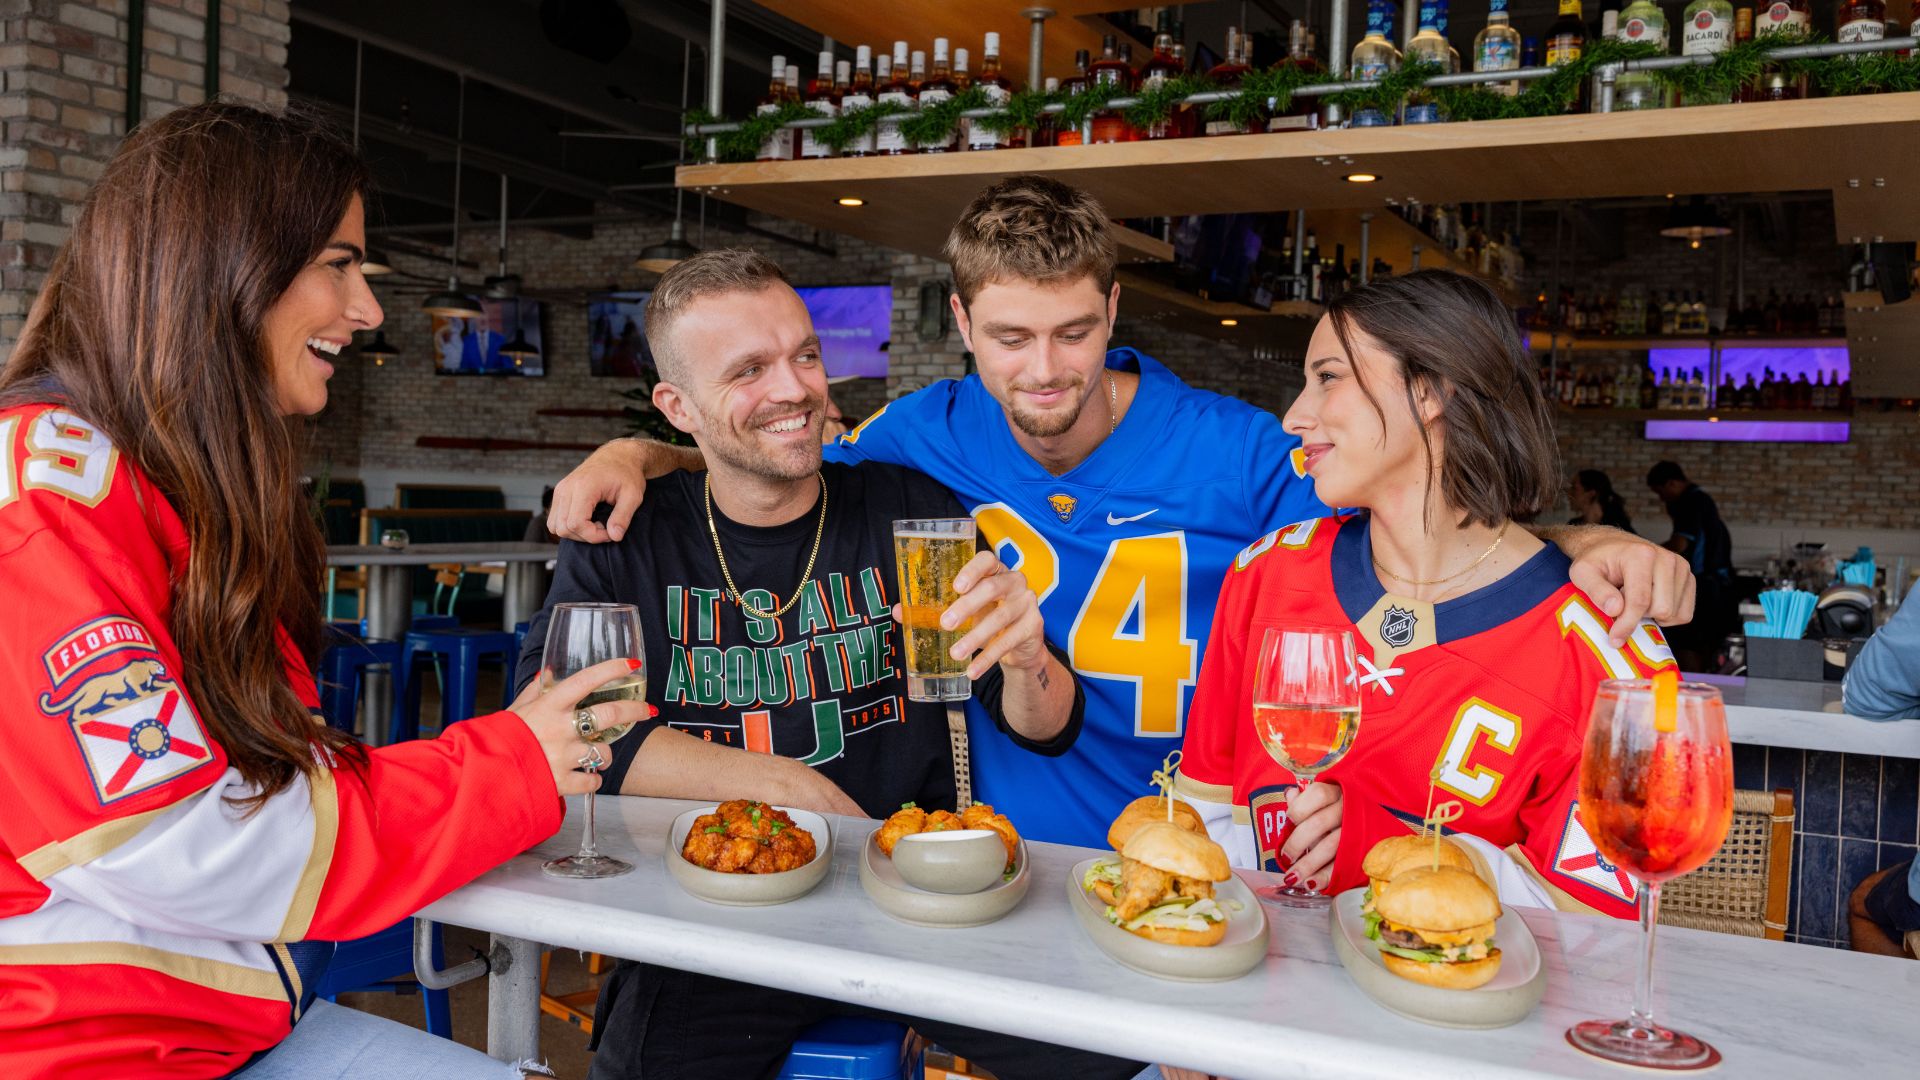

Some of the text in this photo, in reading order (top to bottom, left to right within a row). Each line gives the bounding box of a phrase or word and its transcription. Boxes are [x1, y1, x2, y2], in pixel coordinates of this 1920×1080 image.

[667, 567, 891, 644] IT'S ALL
[1388, 620, 1407, 636] NHL
[60, 623, 144, 668] FLORIDA
[665, 621, 895, 707] ABOUT THE
[681, 698, 891, 767] ST U 1925
[1436, 696, 1522, 806] C
